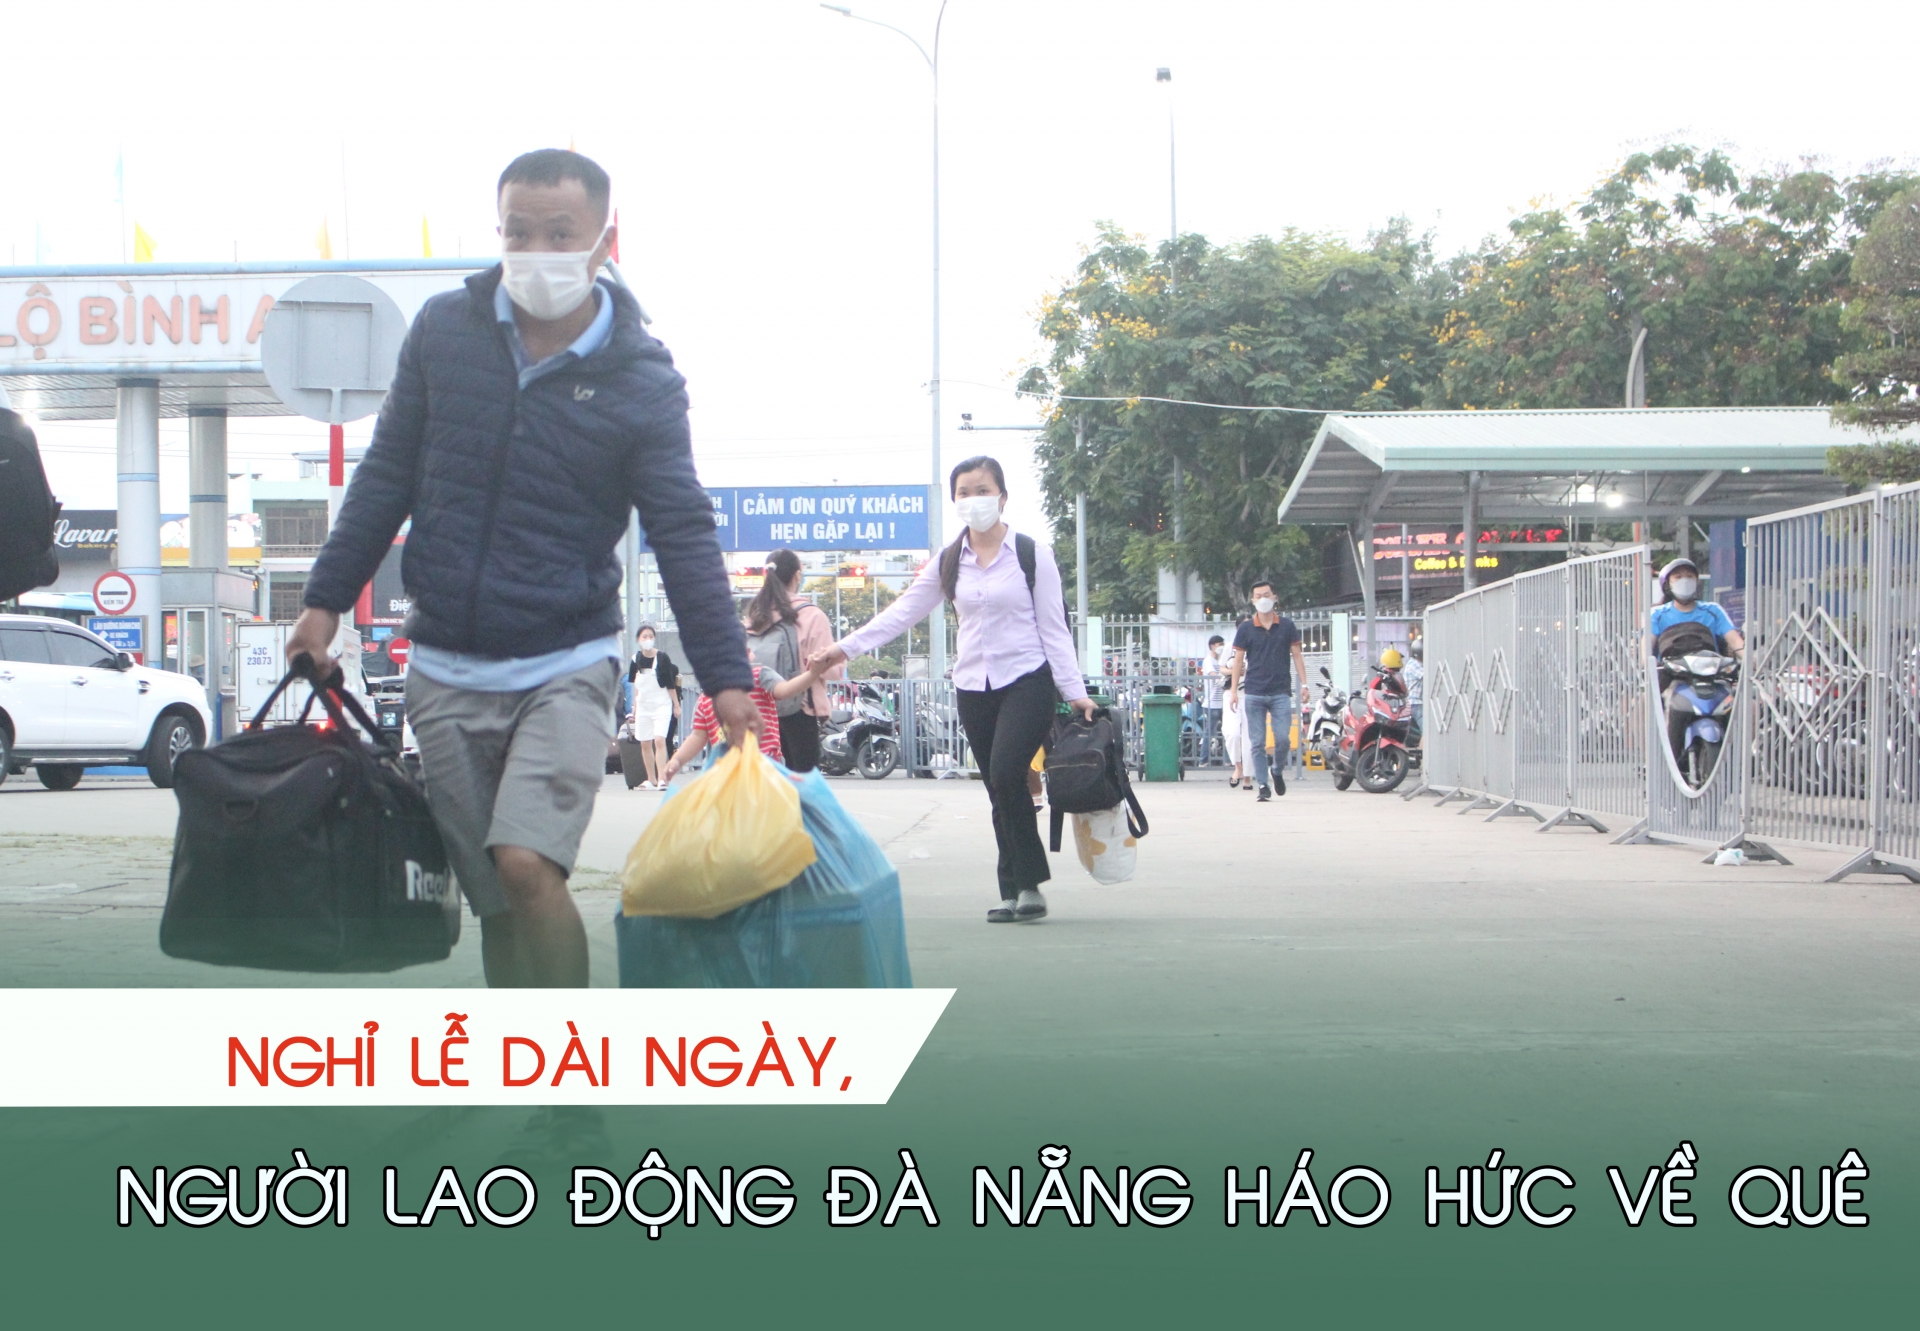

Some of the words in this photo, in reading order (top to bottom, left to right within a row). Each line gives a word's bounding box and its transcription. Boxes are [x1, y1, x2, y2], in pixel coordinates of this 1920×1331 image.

[79, 280, 229, 345] BÌNH
[743, 493, 784, 515] CẢM
[790, 496, 816, 515] ƠN
[821, 494, 857, 516] QUÝ
[862, 494, 923, 514] KHÁCH
[53, 519, 118, 548] Lavar
[770, 523, 807, 543] HẸN
[813, 520, 849, 543] GẶP
[855, 522, 883, 543] LẠI
[889, 522, 896, 539] !
[1414, 557, 1447, 571] Coffee
[1448, 556, 1458, 569] &
[1460, 556, 1498, 569] Dnks
[253, 647, 268, 656] 43C
